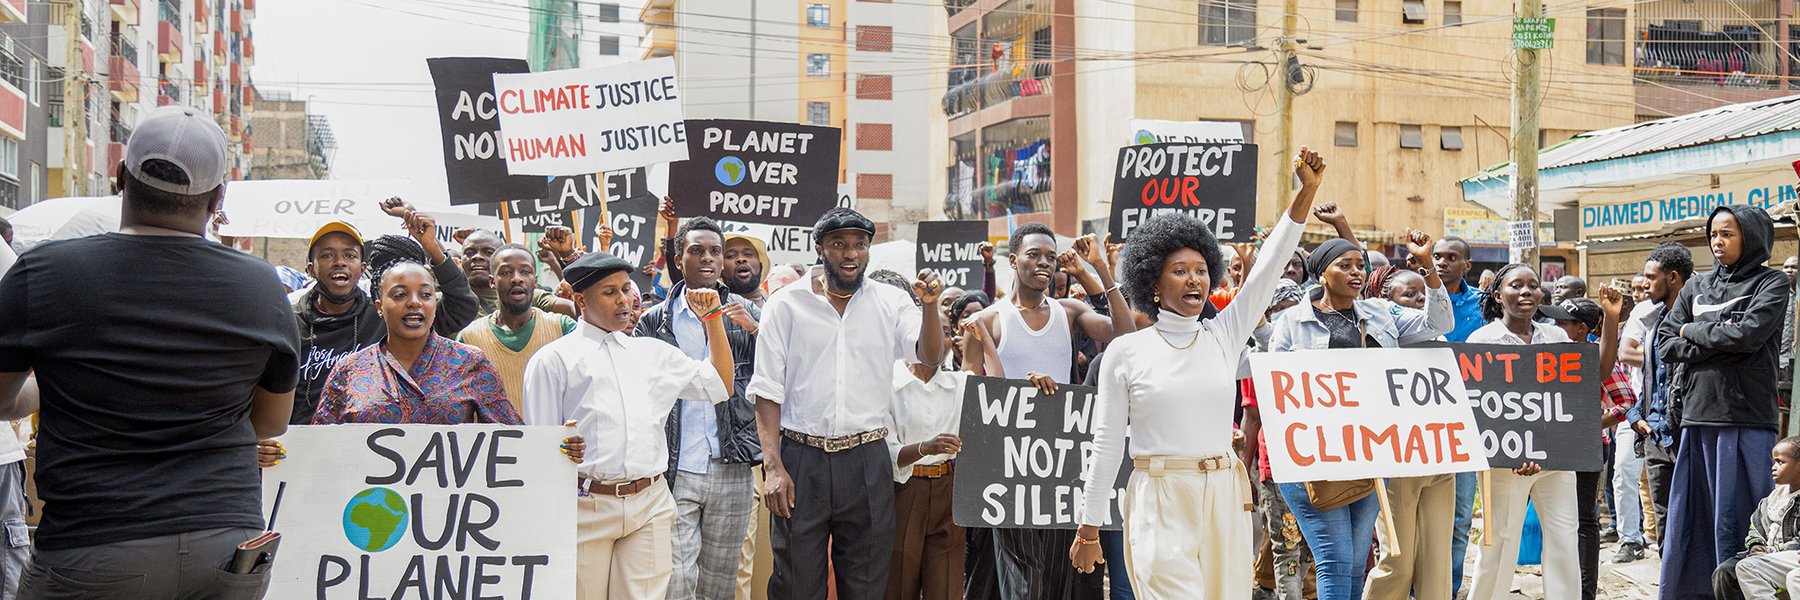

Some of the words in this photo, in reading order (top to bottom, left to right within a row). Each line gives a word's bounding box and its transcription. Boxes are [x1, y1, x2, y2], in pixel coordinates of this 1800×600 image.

[451, 90, 498, 121] AC
[500, 84, 590, 114] CLIMATE
[595, 76, 677, 109] JUSTICE
[508, 133, 587, 162] HUMAN
[601, 121, 685, 152] JUSTICE
[703, 127, 814, 155] PLANET
[1121, 144, 1242, 179] PROTECT
[274, 198, 355, 215] OVER
[709, 190, 798, 218] PROFIT
[1141, 177, 1201, 207] OUR
[1583, 200, 1653, 229] DIAMED
[921, 242, 951, 262] WE
[954, 242, 984, 261] WIL
[1536, 352, 1582, 383] BE
[978, 383, 1039, 428] WE
[1271, 371, 1360, 414] RISE
[1385, 367, 1457, 406] FOR
[365, 428, 524, 488] SAVE
[1004, 436, 1074, 478] NOT
[1285, 422, 1470, 467] CLIMATE
[1480, 429, 1547, 459] OOL
[316, 554, 549, 600] PLANET
